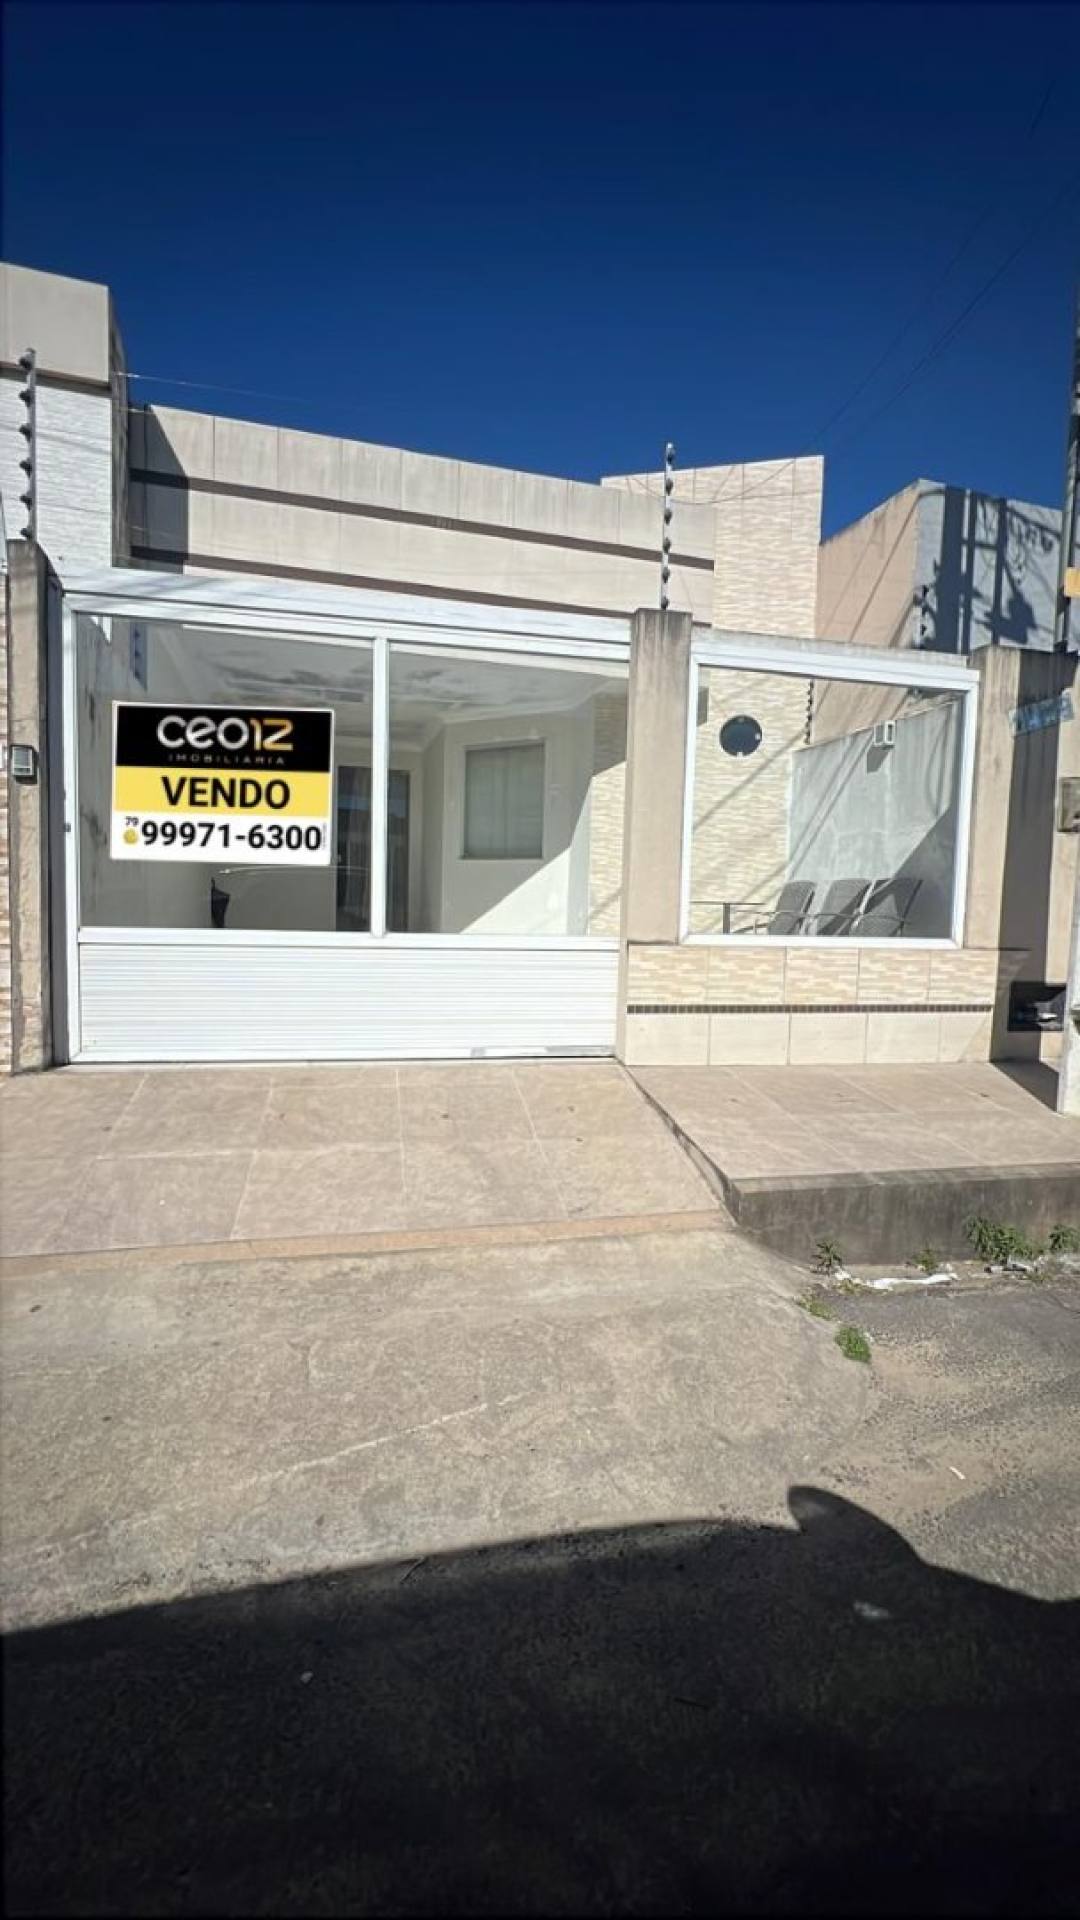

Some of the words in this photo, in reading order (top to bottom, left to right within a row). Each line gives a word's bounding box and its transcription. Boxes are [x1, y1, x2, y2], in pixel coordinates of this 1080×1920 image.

[161, 776, 291, 809] VENDO
[125, 816, 139, 826] 79
[141, 821, 322, 851] 99971-6300
